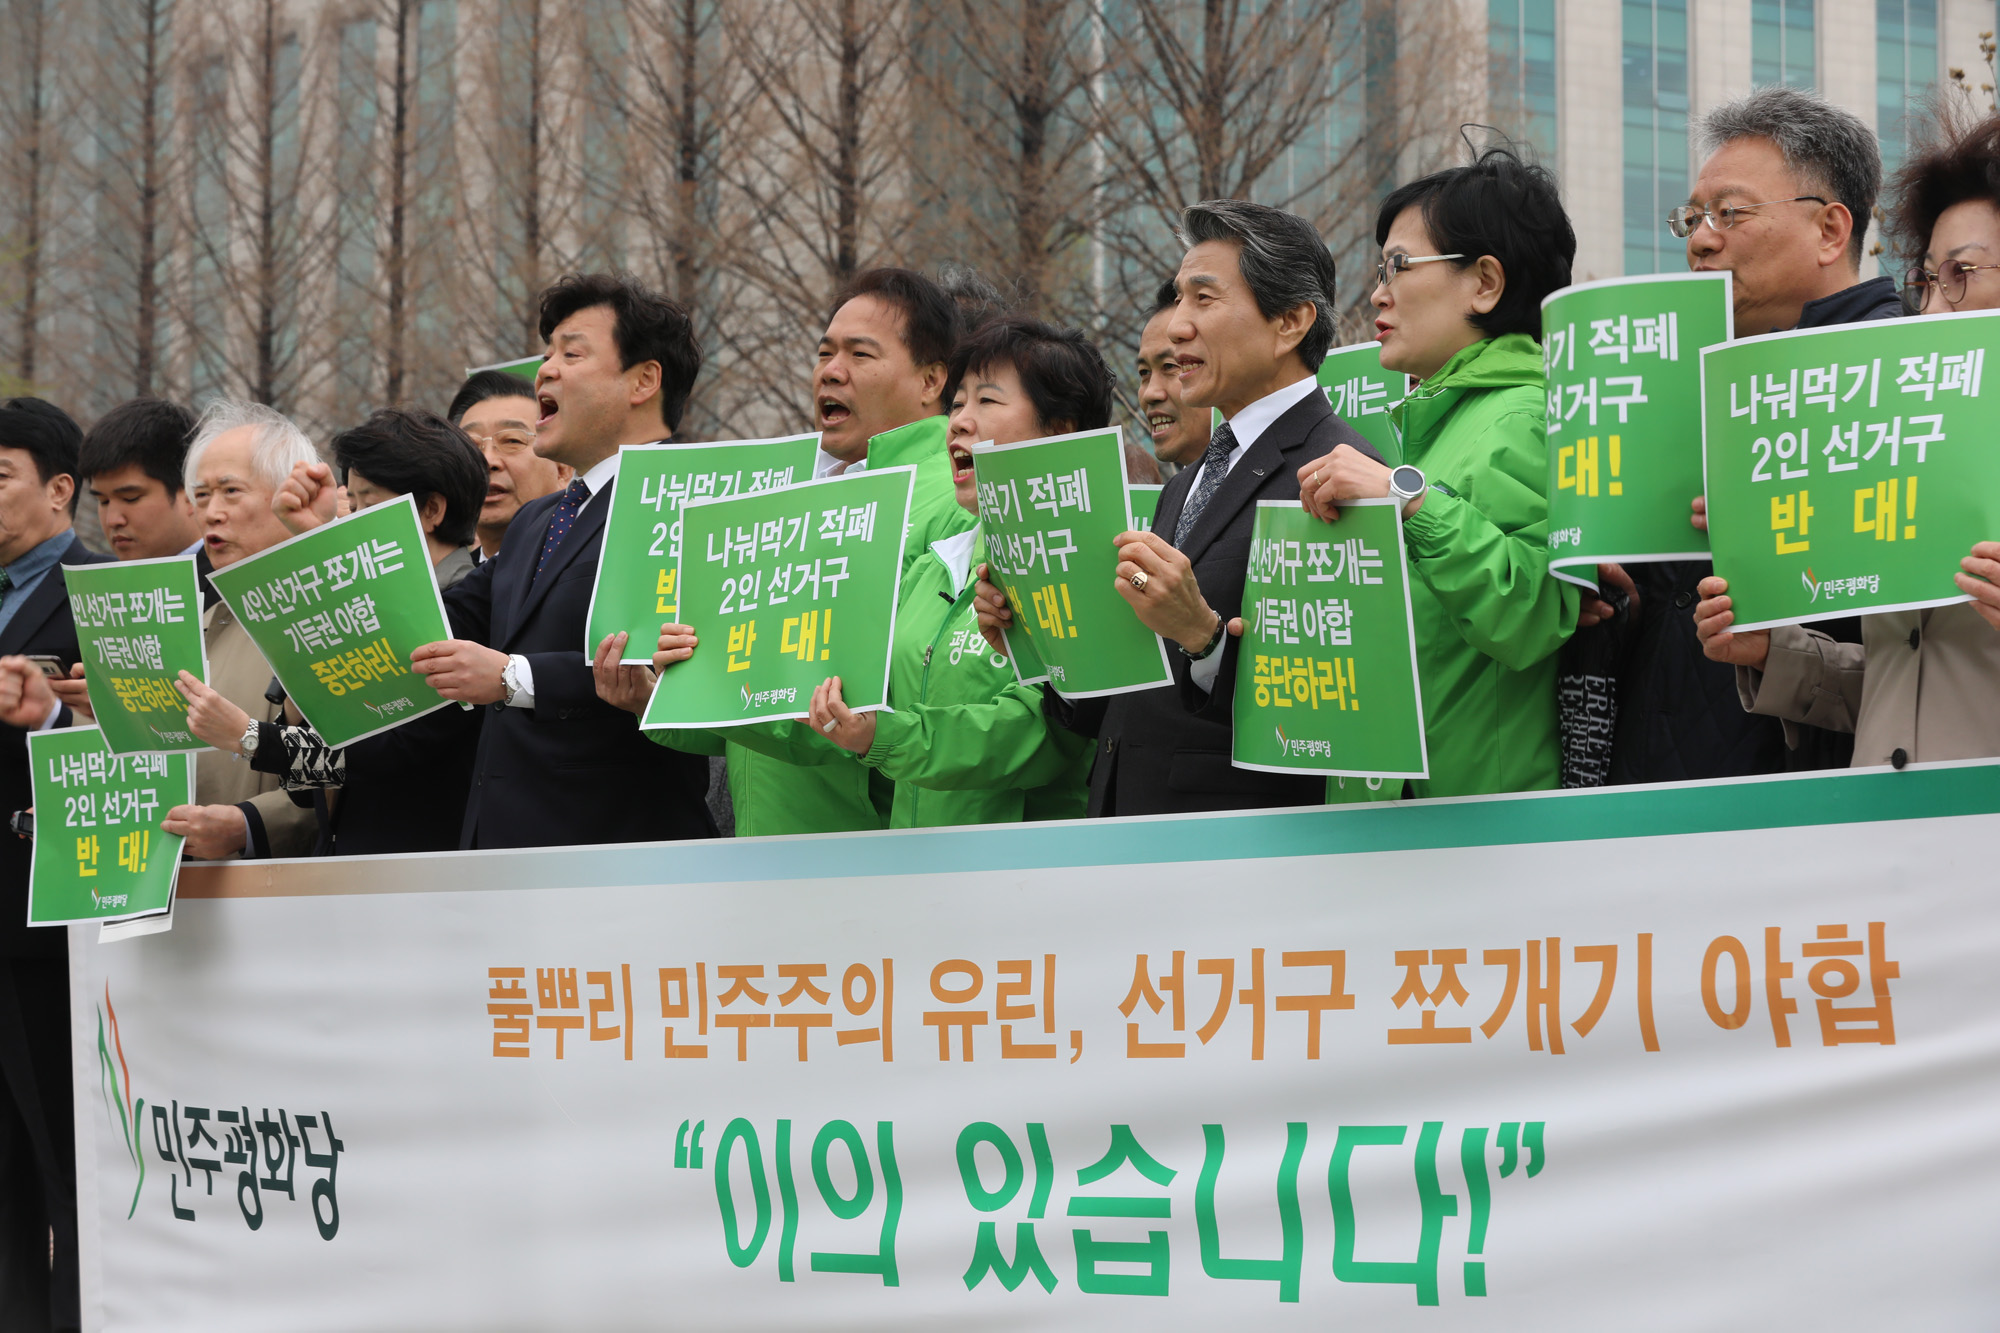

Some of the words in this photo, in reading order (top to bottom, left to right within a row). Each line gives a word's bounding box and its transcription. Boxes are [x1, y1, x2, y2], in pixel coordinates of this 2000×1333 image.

[1588, 312, 1679, 364] 적폐
[1730, 358, 1881, 425] 나눠먹기
[1896, 348, 1985, 401] 적폐
[1557, 435, 1623, 497] 대!
[1751, 428, 1809, 483] 2인
[1822, 413, 1946, 473] 선거구
[1026, 468, 1091, 517] 적폐
[1770, 490, 1814, 555] 반
[1854, 476, 1918, 542] 대!
[706, 511, 811, 568] 나눠먹기
[818, 501, 878, 546] 적폐
[985, 534, 1011, 575] 2인
[1006, 528, 1078, 575] 선거구
[1260, 538, 1303, 586] 선거구
[1306, 538, 1383, 586] 쪼개는
[86, 592, 127, 627] 선거구
[129, 588, 185, 624] 쪼개는
[241, 586, 276, 623] 4인
[269, 565, 324, 614] 선거구
[323, 538, 405, 592] 쪼개는
[719, 570, 761, 615] 2인
[767, 556, 849, 606] 선거구
[1824, 574, 1880, 599] 민주평화당
[283, 610, 343, 654] 기득권
[335, 593, 381, 637] 야합
[1032, 583, 1078, 639] 대!
[1254, 597, 1300, 644] 기득권
[1302, 599, 1353, 646] 야합
[93, 636, 137, 670] 기득권
[132, 635, 164, 670] 야합
[309, 637, 409, 696] 중단하라!
[727, 619, 757, 673] 반
[780, 608, 832, 662] 대!
[110, 677, 189, 713] 중단하라!
[755, 687, 797, 707] 민주평화당
[1254, 654, 1359, 711] 중단하라!
[49, 750, 125, 788] 나눠먹기
[1291, 739, 1331, 758] 민주평화당
[65, 793, 97, 827] 2인
[102, 788, 159, 824] 선거구
[77, 835, 100, 877] 반
[118, 830, 149, 873] 대!
[486, 963, 634, 1061] 풀뿌리
[658, 958, 894, 1063] 민주주의
[922, 953, 1083, 1065] 유린,
[1117, 947, 1356, 1061] 선거구
[1386, 932, 1661, 1056] 쪼개기
[1699, 921, 1901, 1049] 야합
[150, 1100, 345, 1241] 민주평화당
[673, 1117, 904, 1288] “이의
[955, 1121, 1546, 1307] 있습니다!”
